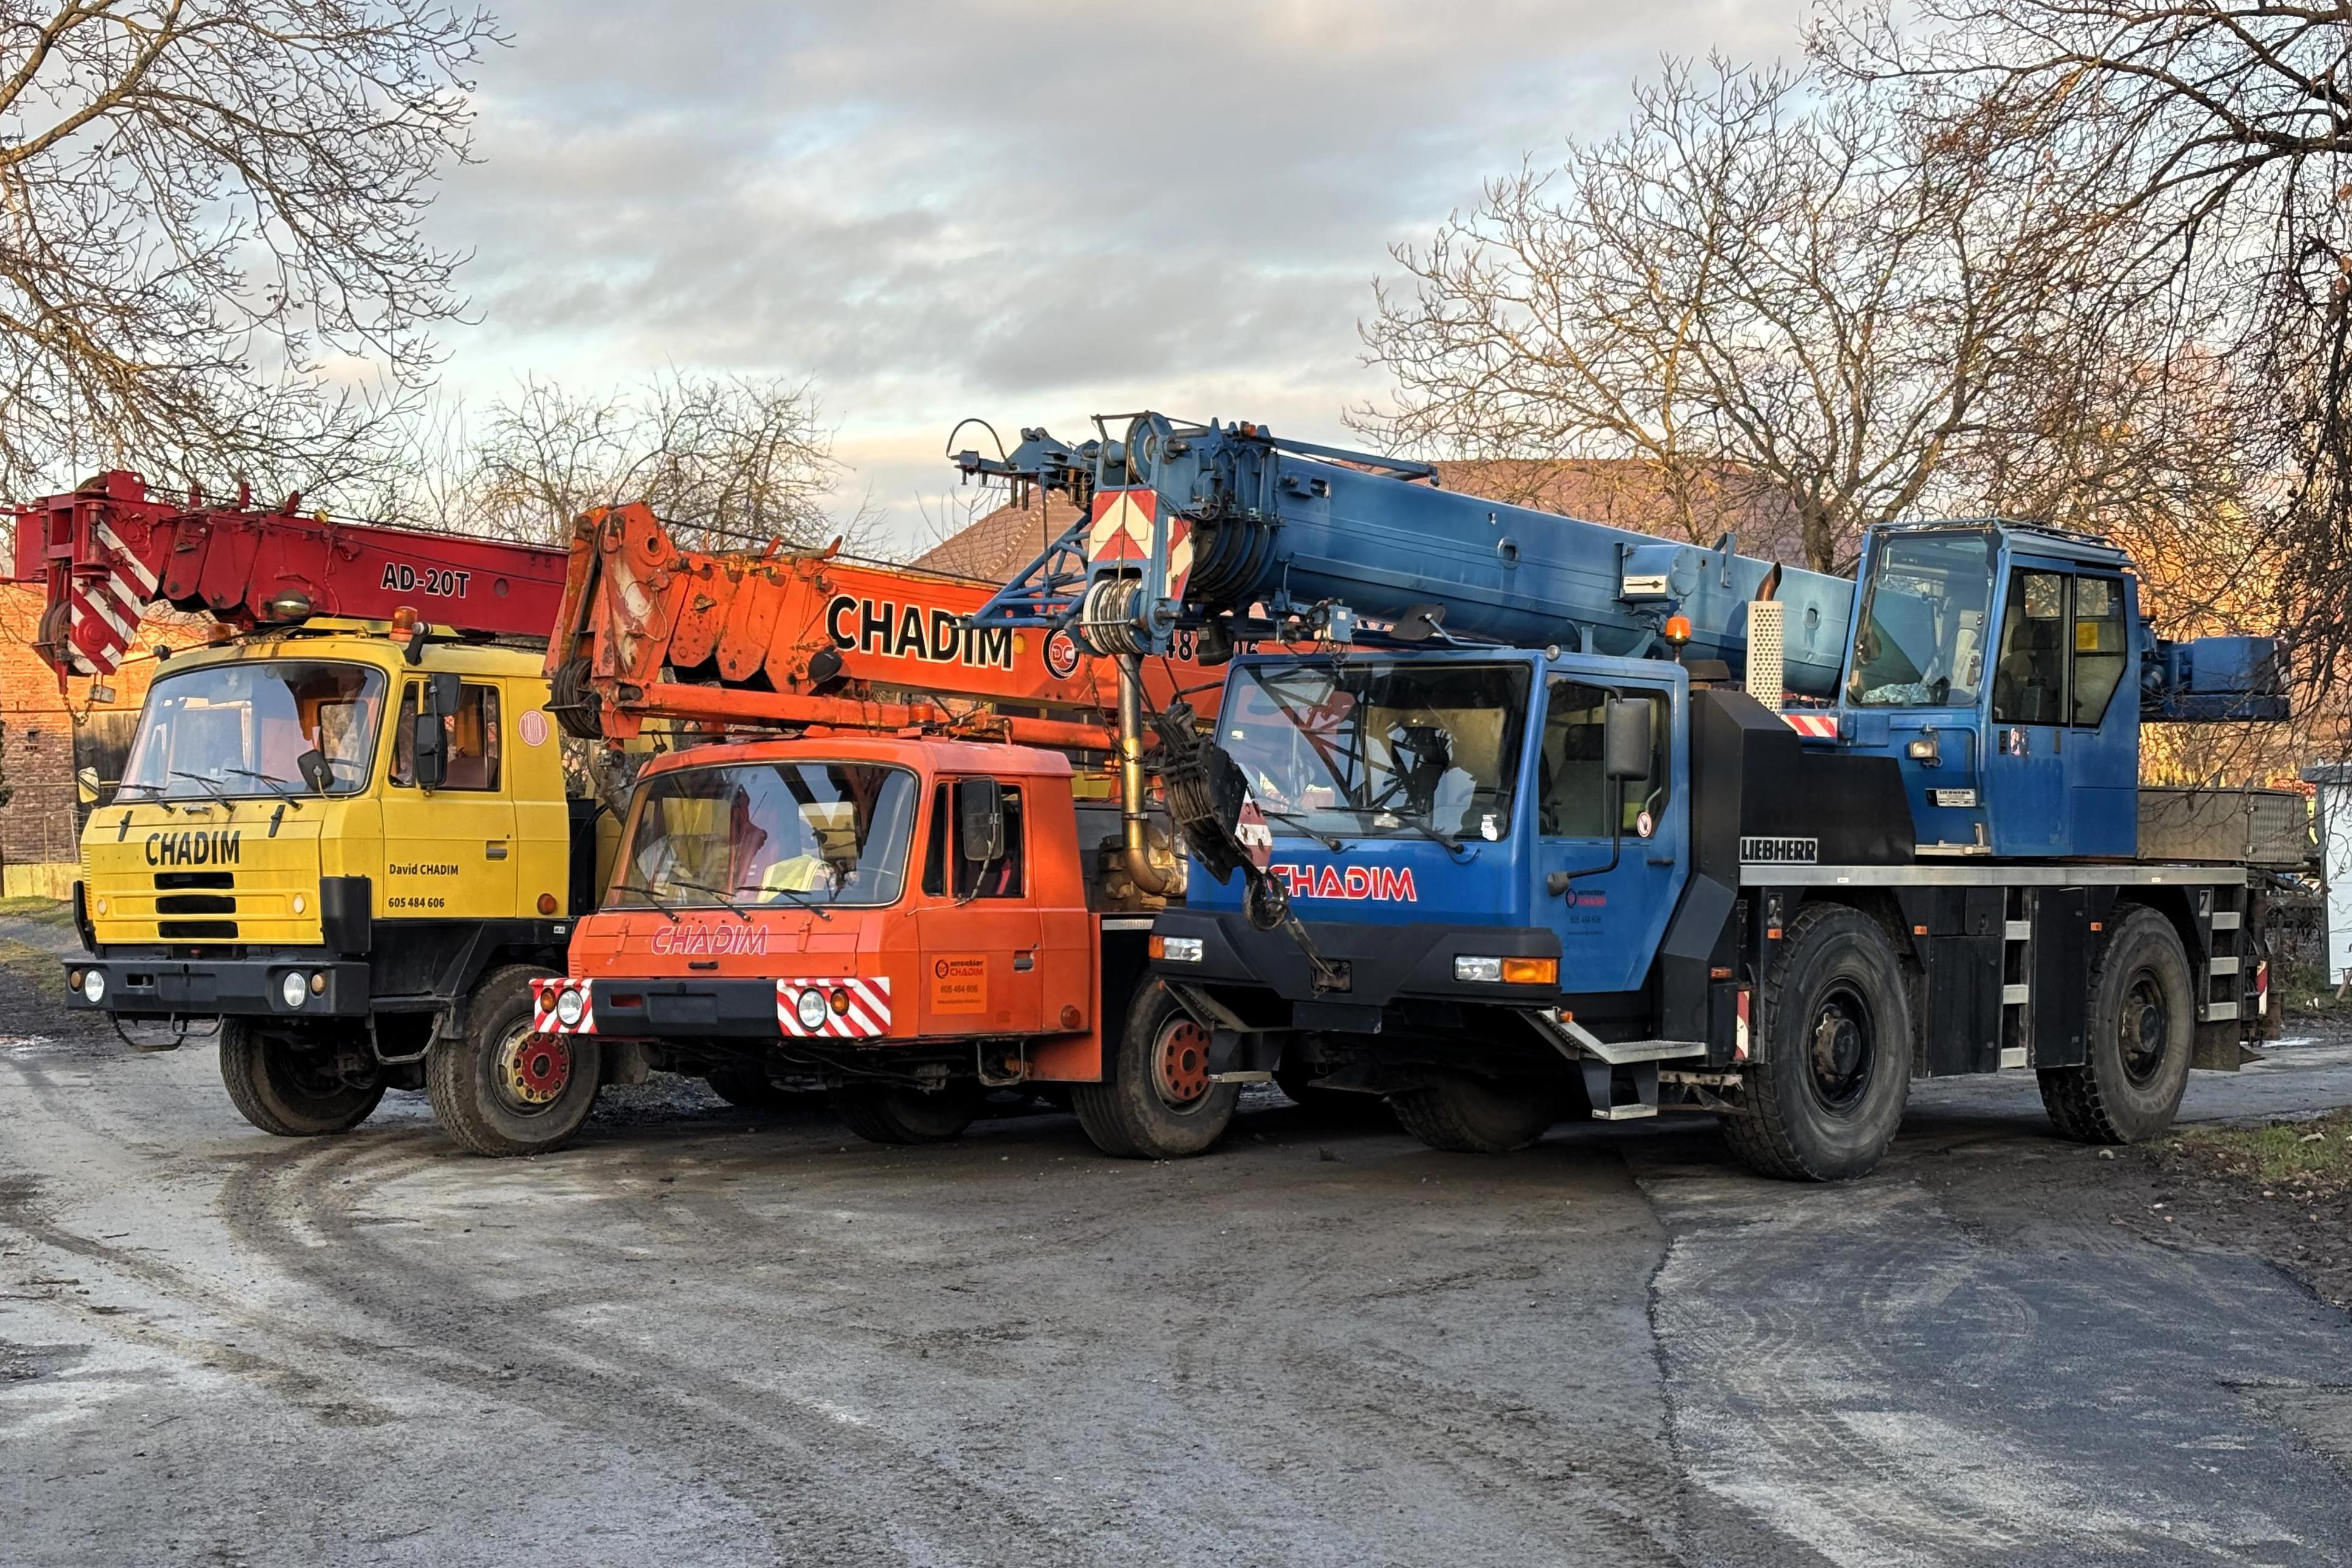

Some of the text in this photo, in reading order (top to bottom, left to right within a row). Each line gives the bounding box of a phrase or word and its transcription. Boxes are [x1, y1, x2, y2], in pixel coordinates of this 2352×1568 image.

[381, 562, 471, 599] AD-20T
[826, 594, 1014, 672] CHADIM
[145, 830, 241, 866] CHADIM
[1740, 839, 1816, 861] LIEBHERR
[389, 863, 458, 875] David CHADIM
[388, 898, 445, 907] 605 484 606
[651, 924, 768, 955] CHADIM
[950, 968, 984, 976] CHADIM
